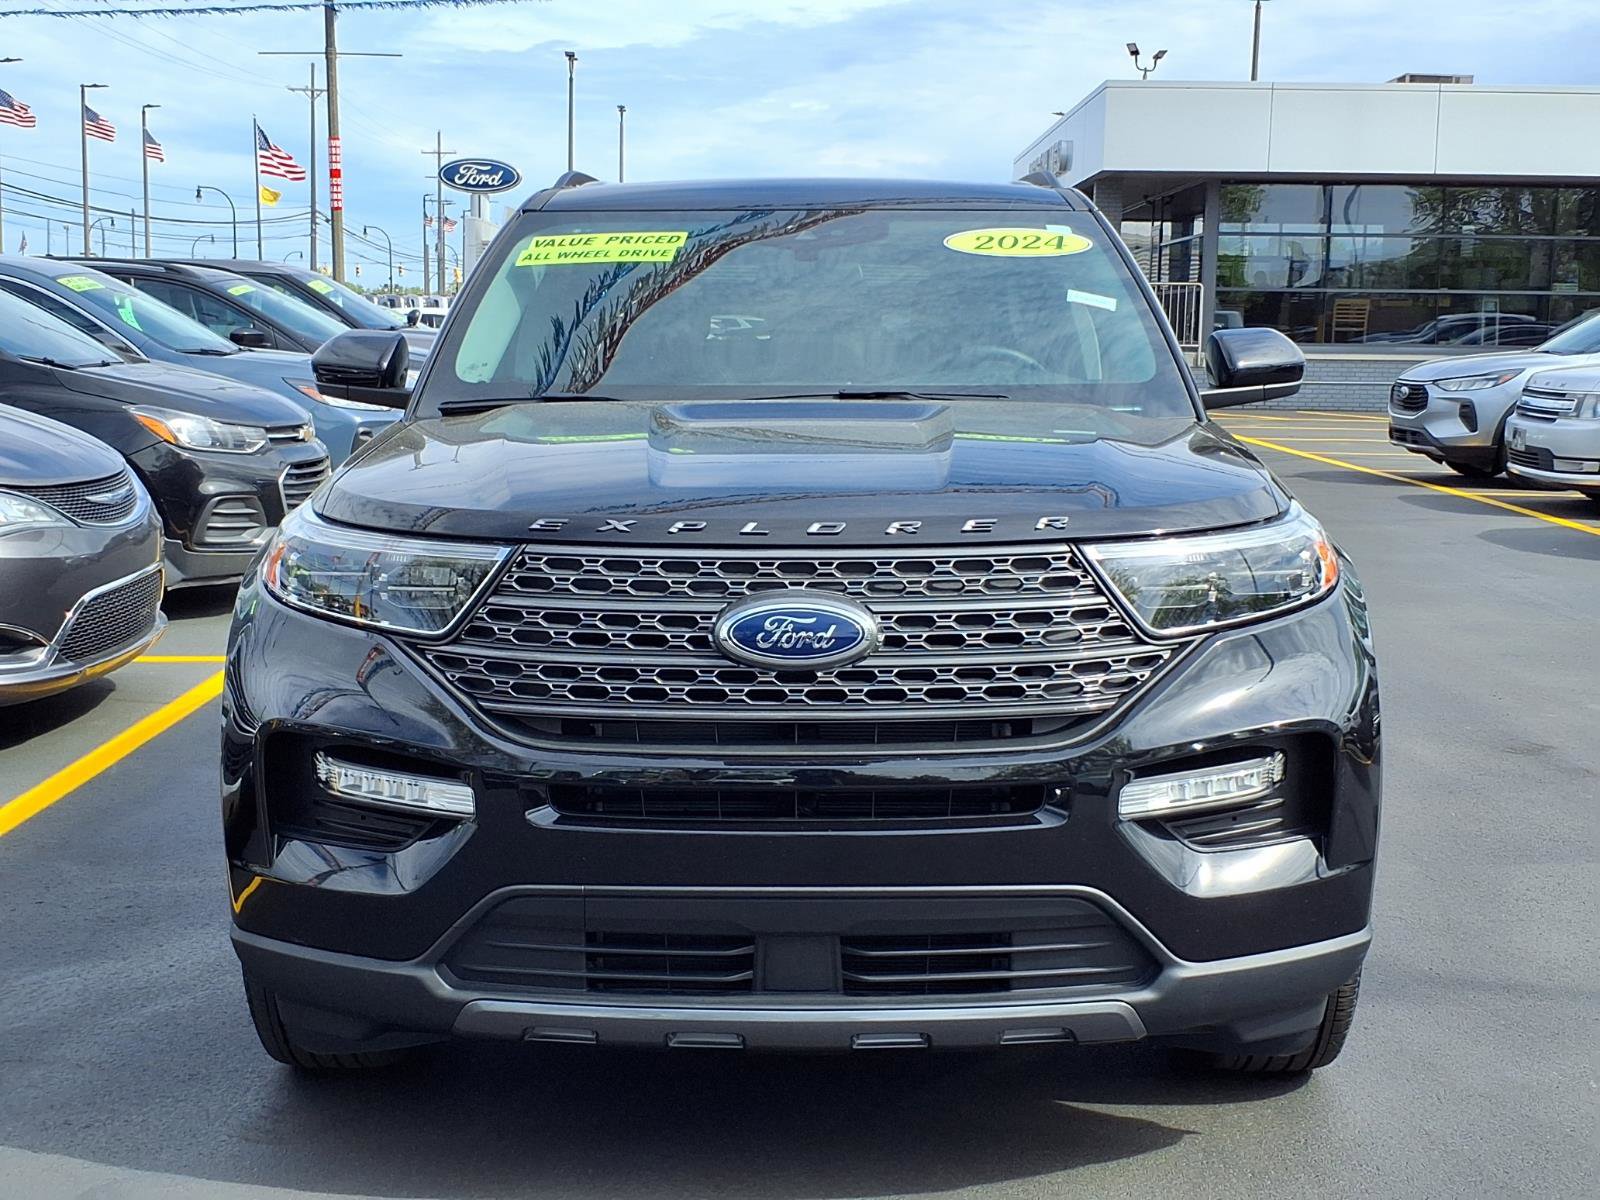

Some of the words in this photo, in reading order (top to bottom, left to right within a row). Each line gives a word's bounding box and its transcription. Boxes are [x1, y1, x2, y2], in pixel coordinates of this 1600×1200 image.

[454, 164, 504, 186] Ford
[534, 237, 596, 248] VALUE
[605, 235, 682, 245] PRICED
[974, 235, 1067, 250] 2024
[522, 252, 554, 262] ALL
[557, 249, 611, 259] WHEEL
[618, 249, 671, 257] DRIVE
[528, 515, 1070, 535] EXPLORER
[755, 615, 837, 650] Ford
